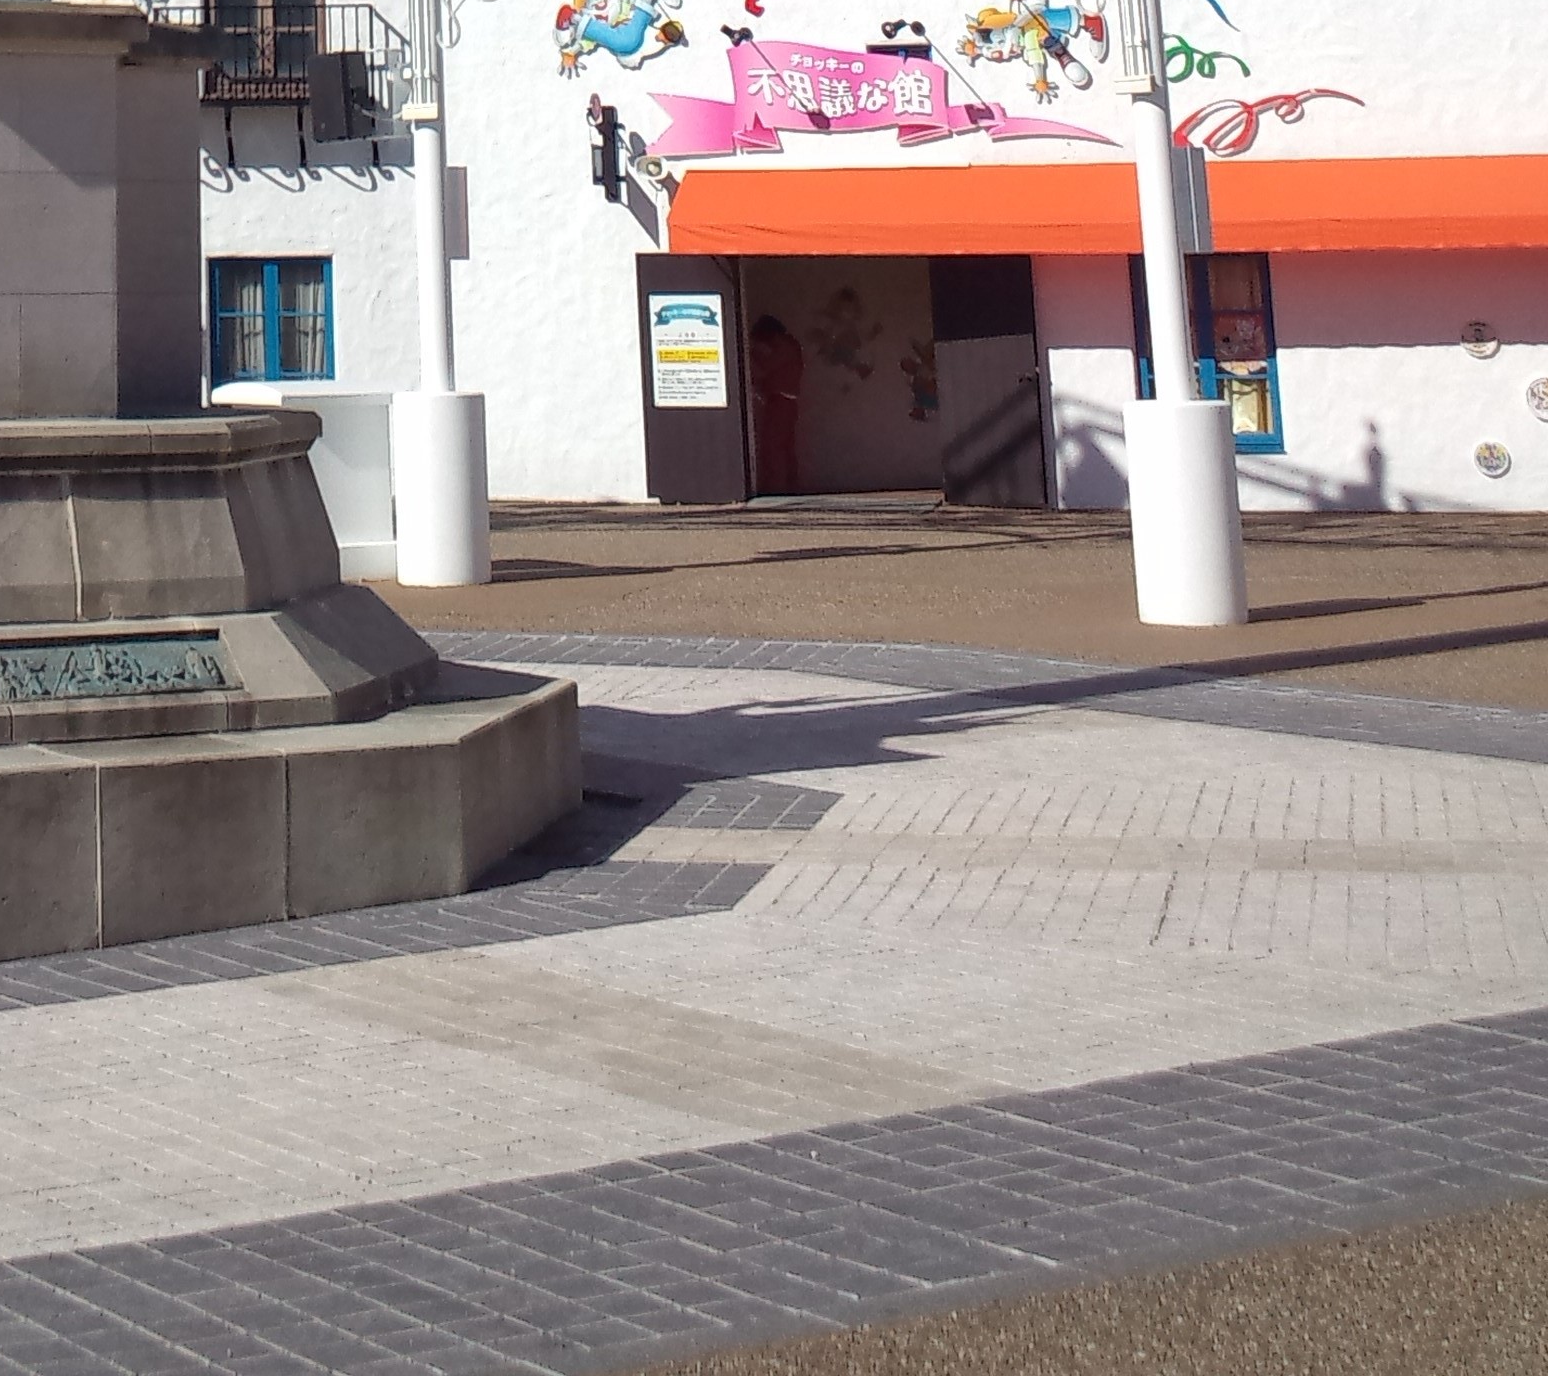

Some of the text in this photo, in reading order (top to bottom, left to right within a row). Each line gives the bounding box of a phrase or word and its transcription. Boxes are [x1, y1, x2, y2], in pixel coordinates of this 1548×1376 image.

[789, 52, 865, 74] チョッキーの
[746, 68, 934, 119] 不思議な館
